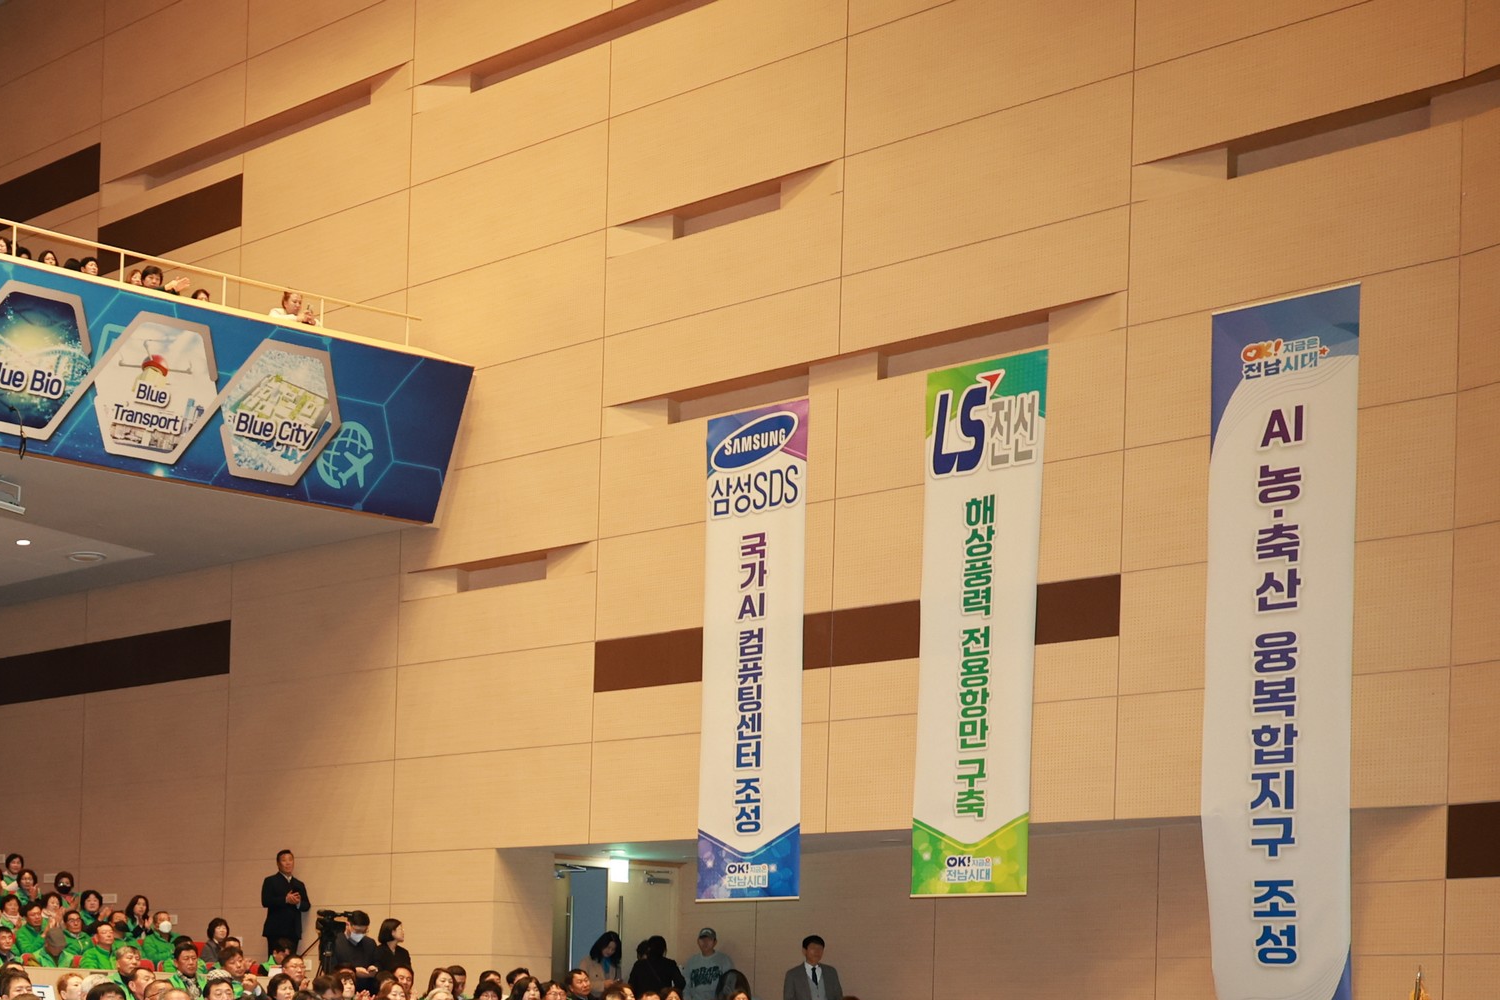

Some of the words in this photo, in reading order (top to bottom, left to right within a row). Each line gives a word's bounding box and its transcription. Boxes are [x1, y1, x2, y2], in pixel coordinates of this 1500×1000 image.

[1283, 337, 1319, 354] 지금은
[1244, 351, 1318, 381] 전남시대
[29, 370, 63, 396] Bio
[136, 383, 168, 404] Blue
[113, 404, 181, 432] Transport
[235, 412, 275, 438] Blue
[278, 420, 315, 447] City
[1260, 404, 1304, 448] AI
[724, 428, 787, 457] SAMSUNG
[710, 464, 799, 517] 삼성SDS
[962, 494, 997, 616] 해상풍력
[735, 627, 764, 770] 컴퓨팅센터
[958, 626, 991, 750] 전용항만
[1250, 630, 1298, 860] 융복합지구
[956, 758, 987, 818] 구축
[734, 777, 762, 834] 조성
[727, 863, 749, 874] OK!
[946, 856, 971, 868] OK!
[946, 868, 991, 882] 전남시대
[727, 874, 767, 888] 전남시대
[1253, 878, 1298, 966] 조성
